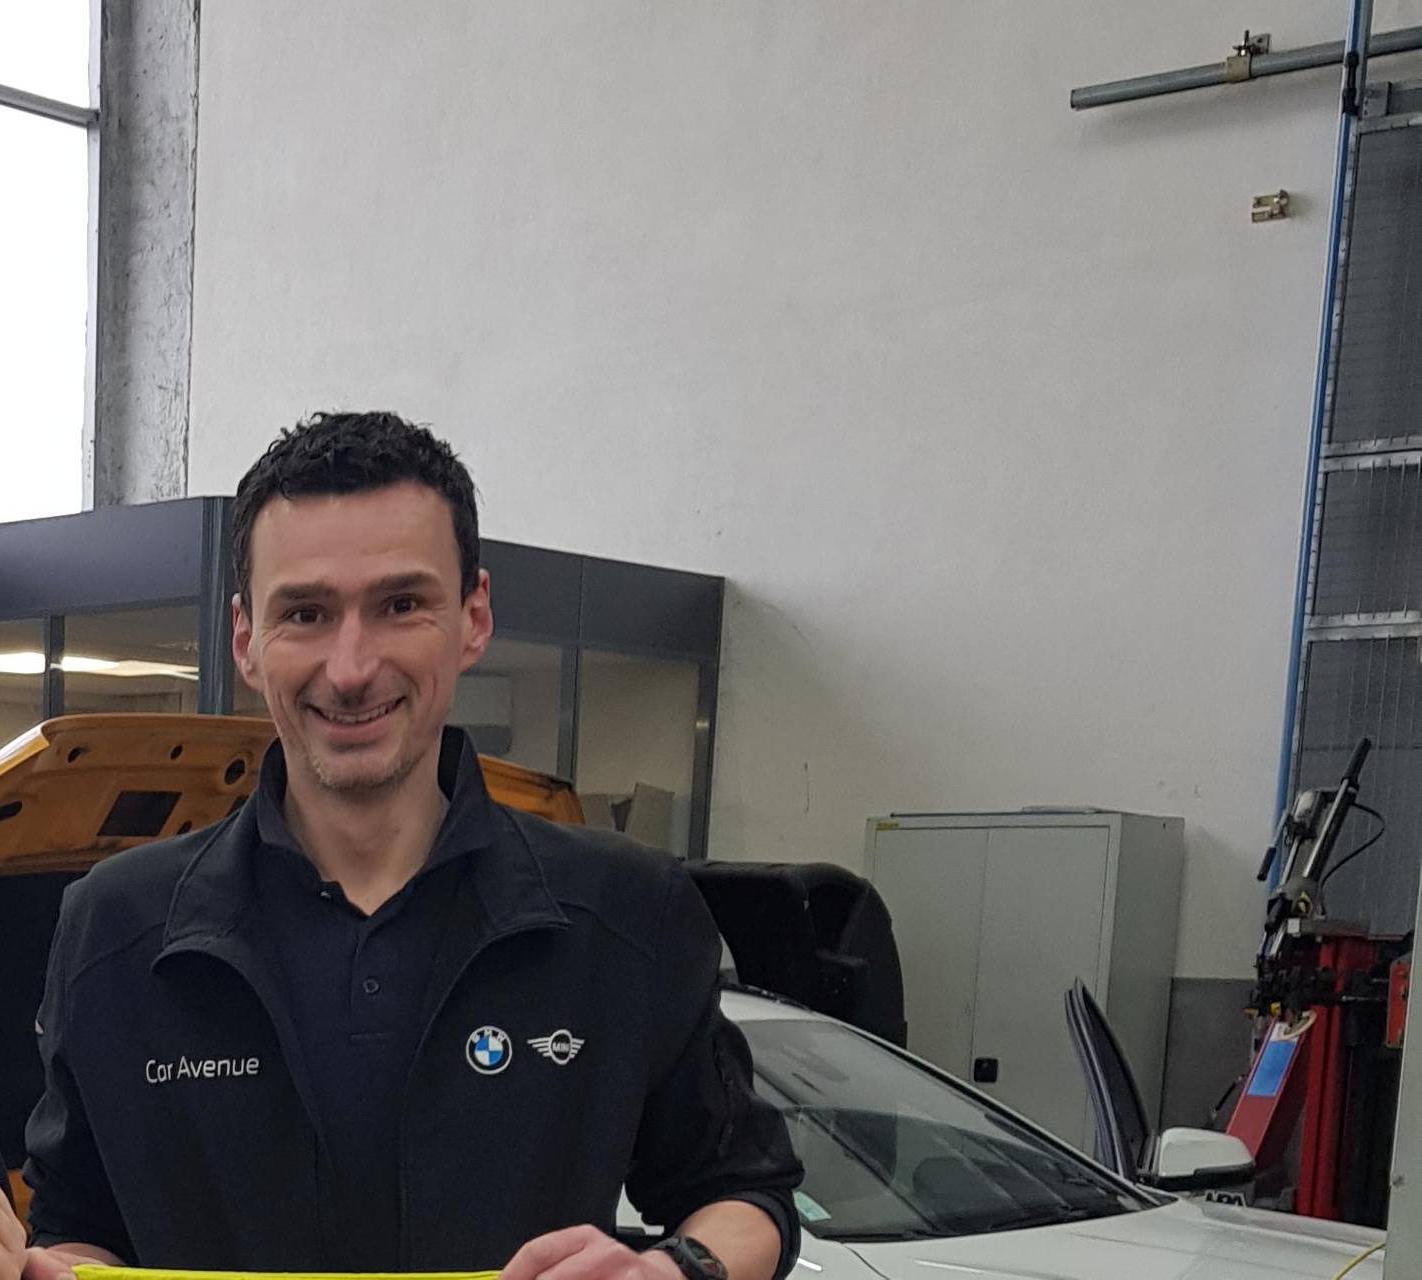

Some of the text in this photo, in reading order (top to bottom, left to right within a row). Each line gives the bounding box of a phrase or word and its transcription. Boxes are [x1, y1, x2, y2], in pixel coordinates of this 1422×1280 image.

[552, 1041, 572, 1053] MINI
[146, 1056, 260, 1083] Car Avenue
